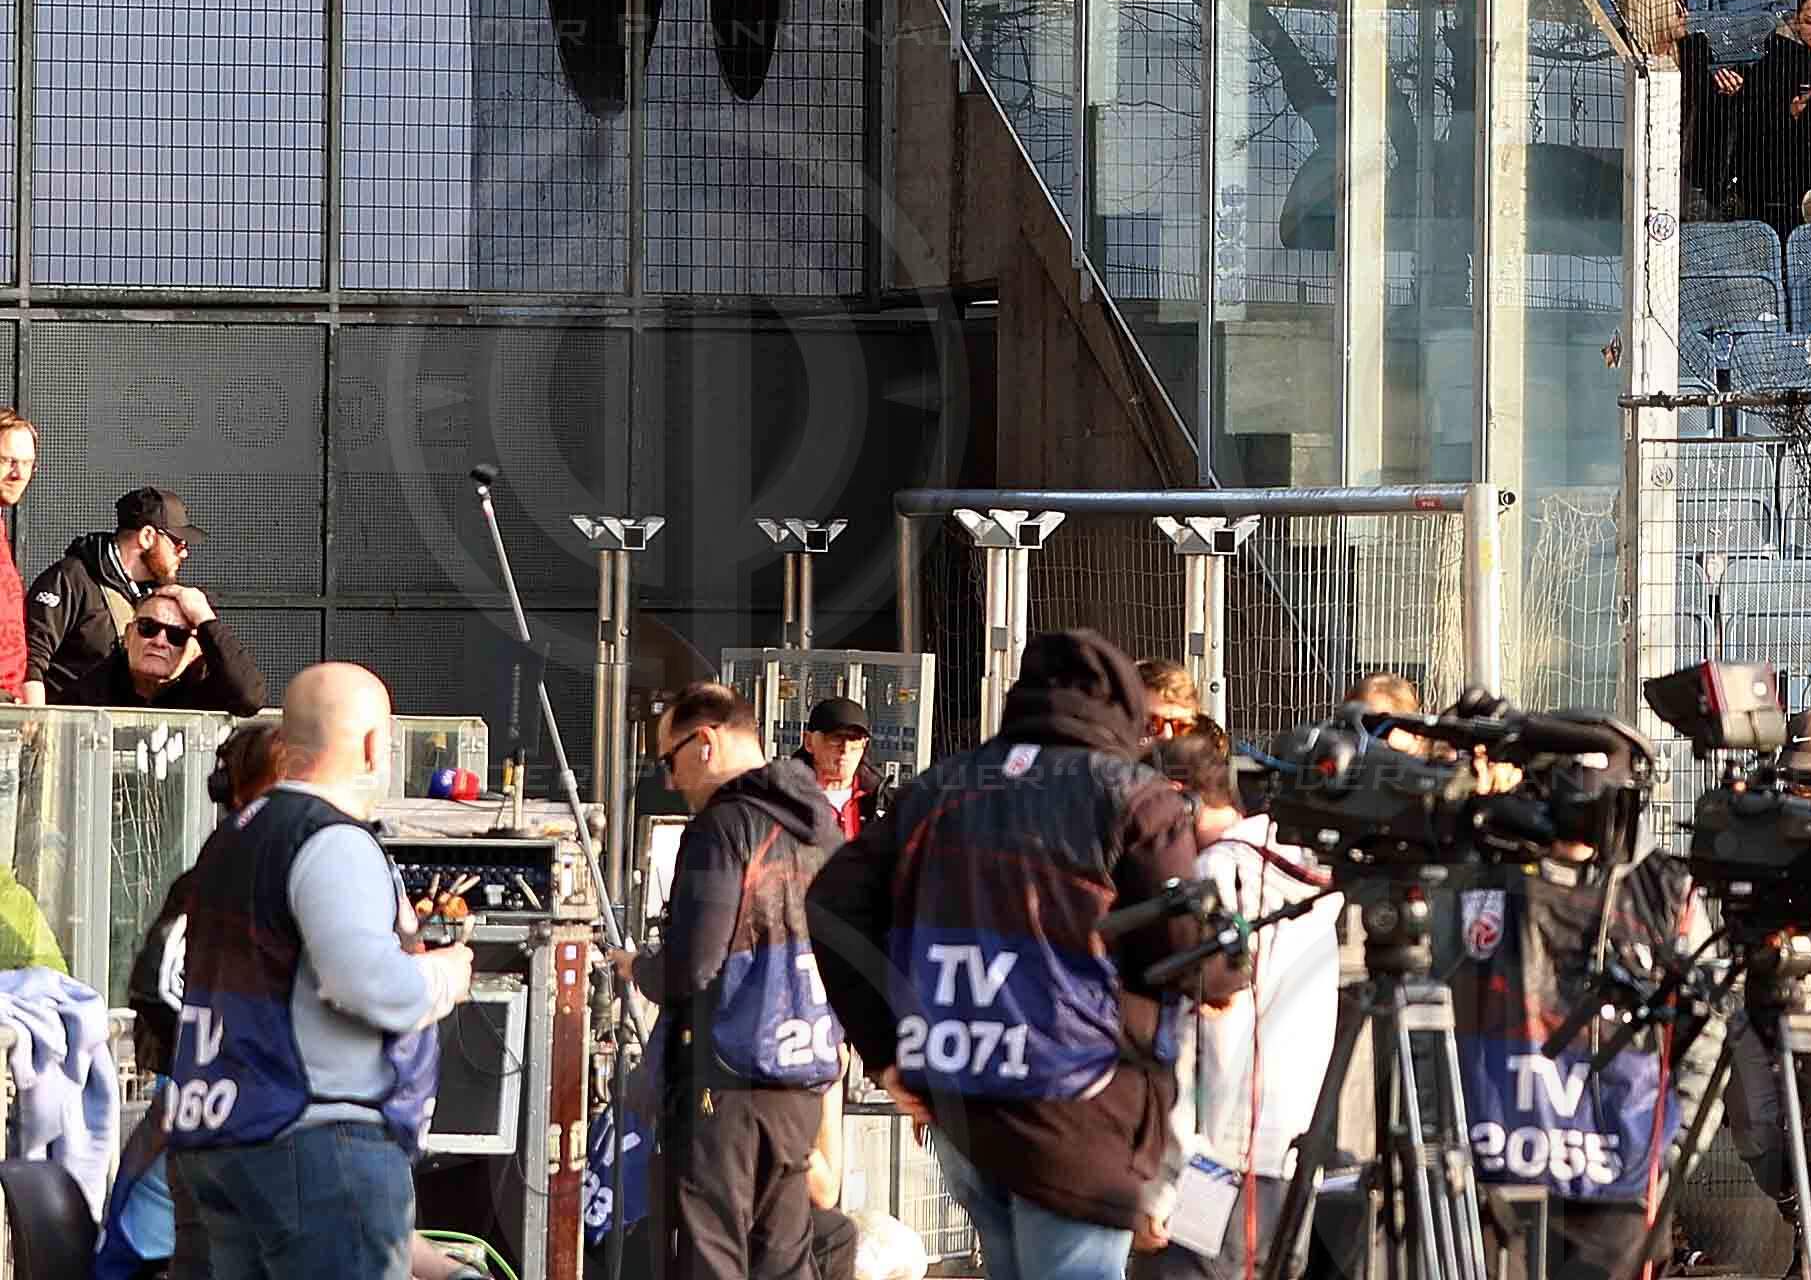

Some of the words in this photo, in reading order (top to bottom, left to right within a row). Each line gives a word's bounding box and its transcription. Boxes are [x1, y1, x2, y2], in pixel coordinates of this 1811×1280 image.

[926, 944, 1019, 1008] TV
[895, 1014, 1030, 1081] 2071
[1506, 1052, 1592, 1119] TV
